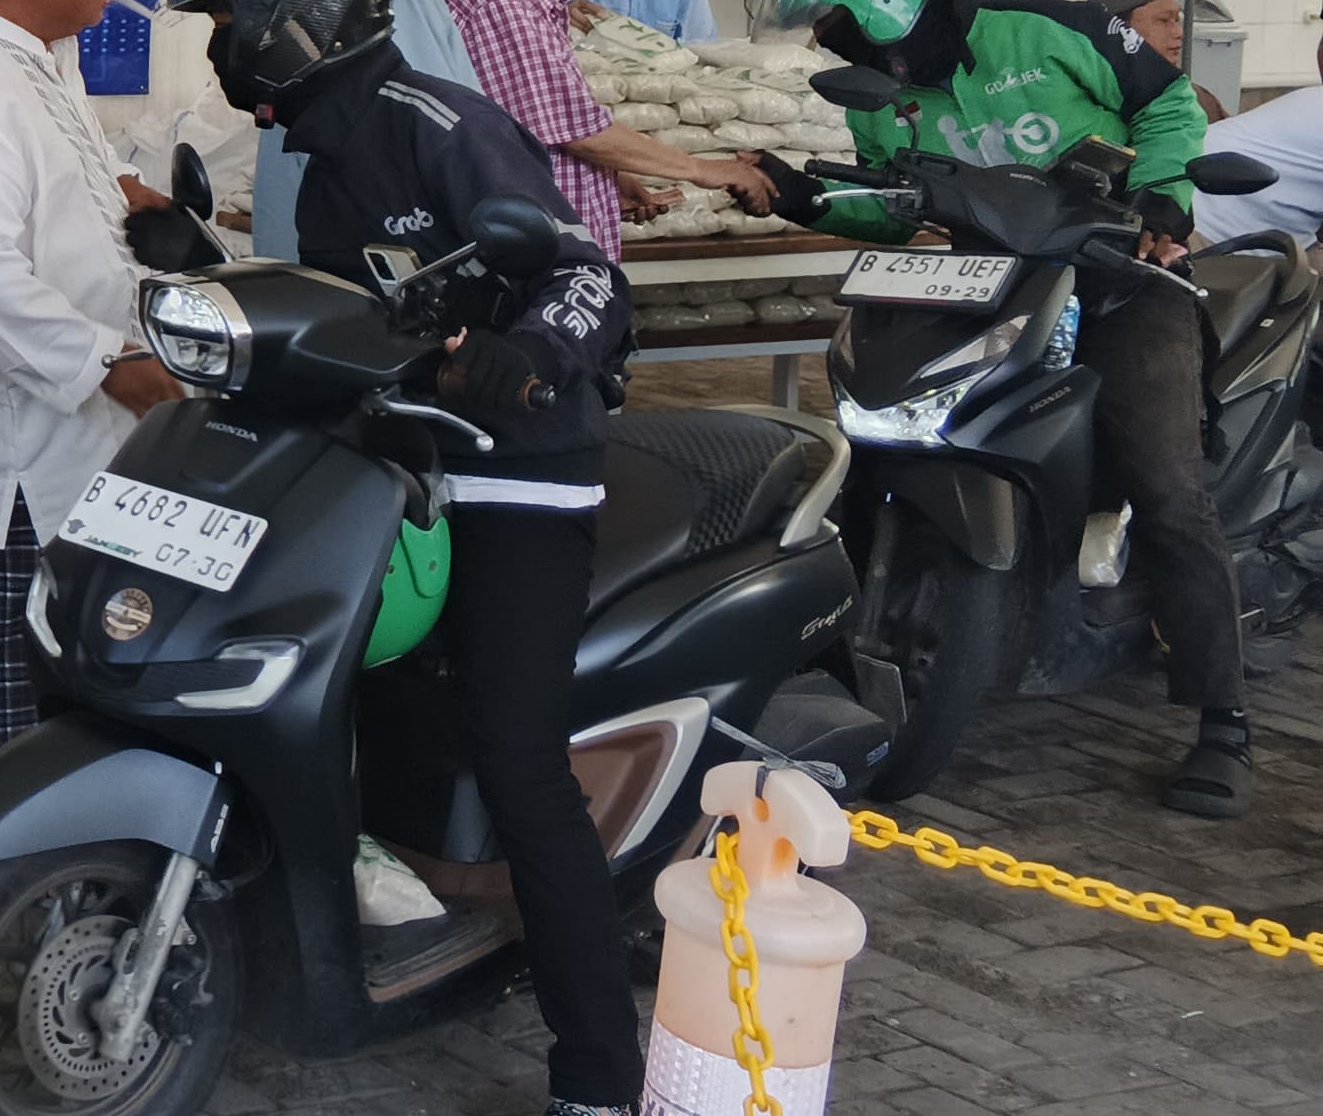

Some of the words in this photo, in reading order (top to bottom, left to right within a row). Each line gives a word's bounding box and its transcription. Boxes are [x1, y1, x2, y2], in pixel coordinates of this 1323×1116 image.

[384, 206, 434, 235] Grab
[859, 254, 878, 273] B
[885, 257, 945, 276] 4551
[957, 259, 1008, 279] UEF
[205, 419, 259, 443] HONDA
[83, 476, 107, 503] B
[114, 485, 189, 529] 4682
[199, 508, 260, 549] UFN
